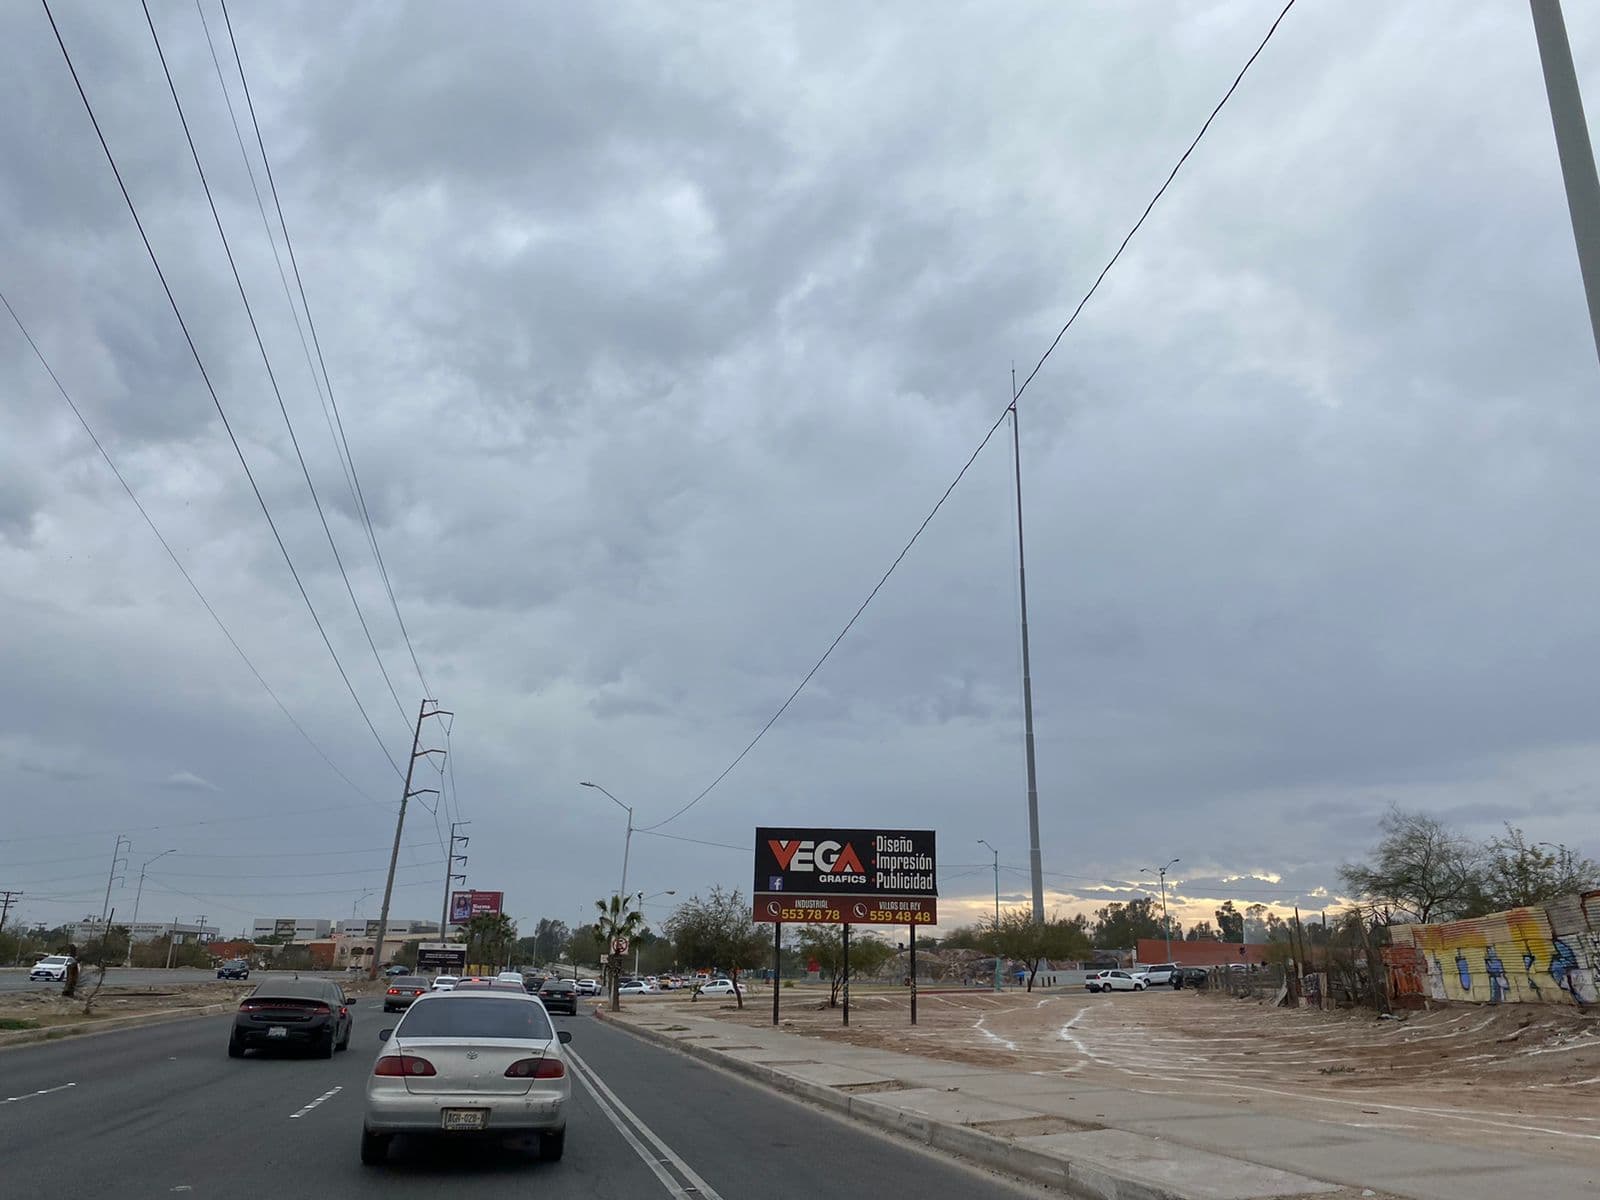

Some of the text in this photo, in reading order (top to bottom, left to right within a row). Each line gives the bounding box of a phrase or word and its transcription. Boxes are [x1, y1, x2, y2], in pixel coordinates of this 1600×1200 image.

[876, 835, 913, 853] Diseño
[768, 840, 865, 873] VEGA
[876, 852, 933, 872] Impresión
[819, 875, 867, 884] GRAFICS
[876, 871, 933, 890] Publicidad
[795, 899, 828, 909] INDUSTRIAL
[879, 901, 899, 911] VILLAS
[899, 902, 909, 911] DEL
[781, 908, 840, 920] 553 78 78
[870, 911, 931, 922] 559 48 48
